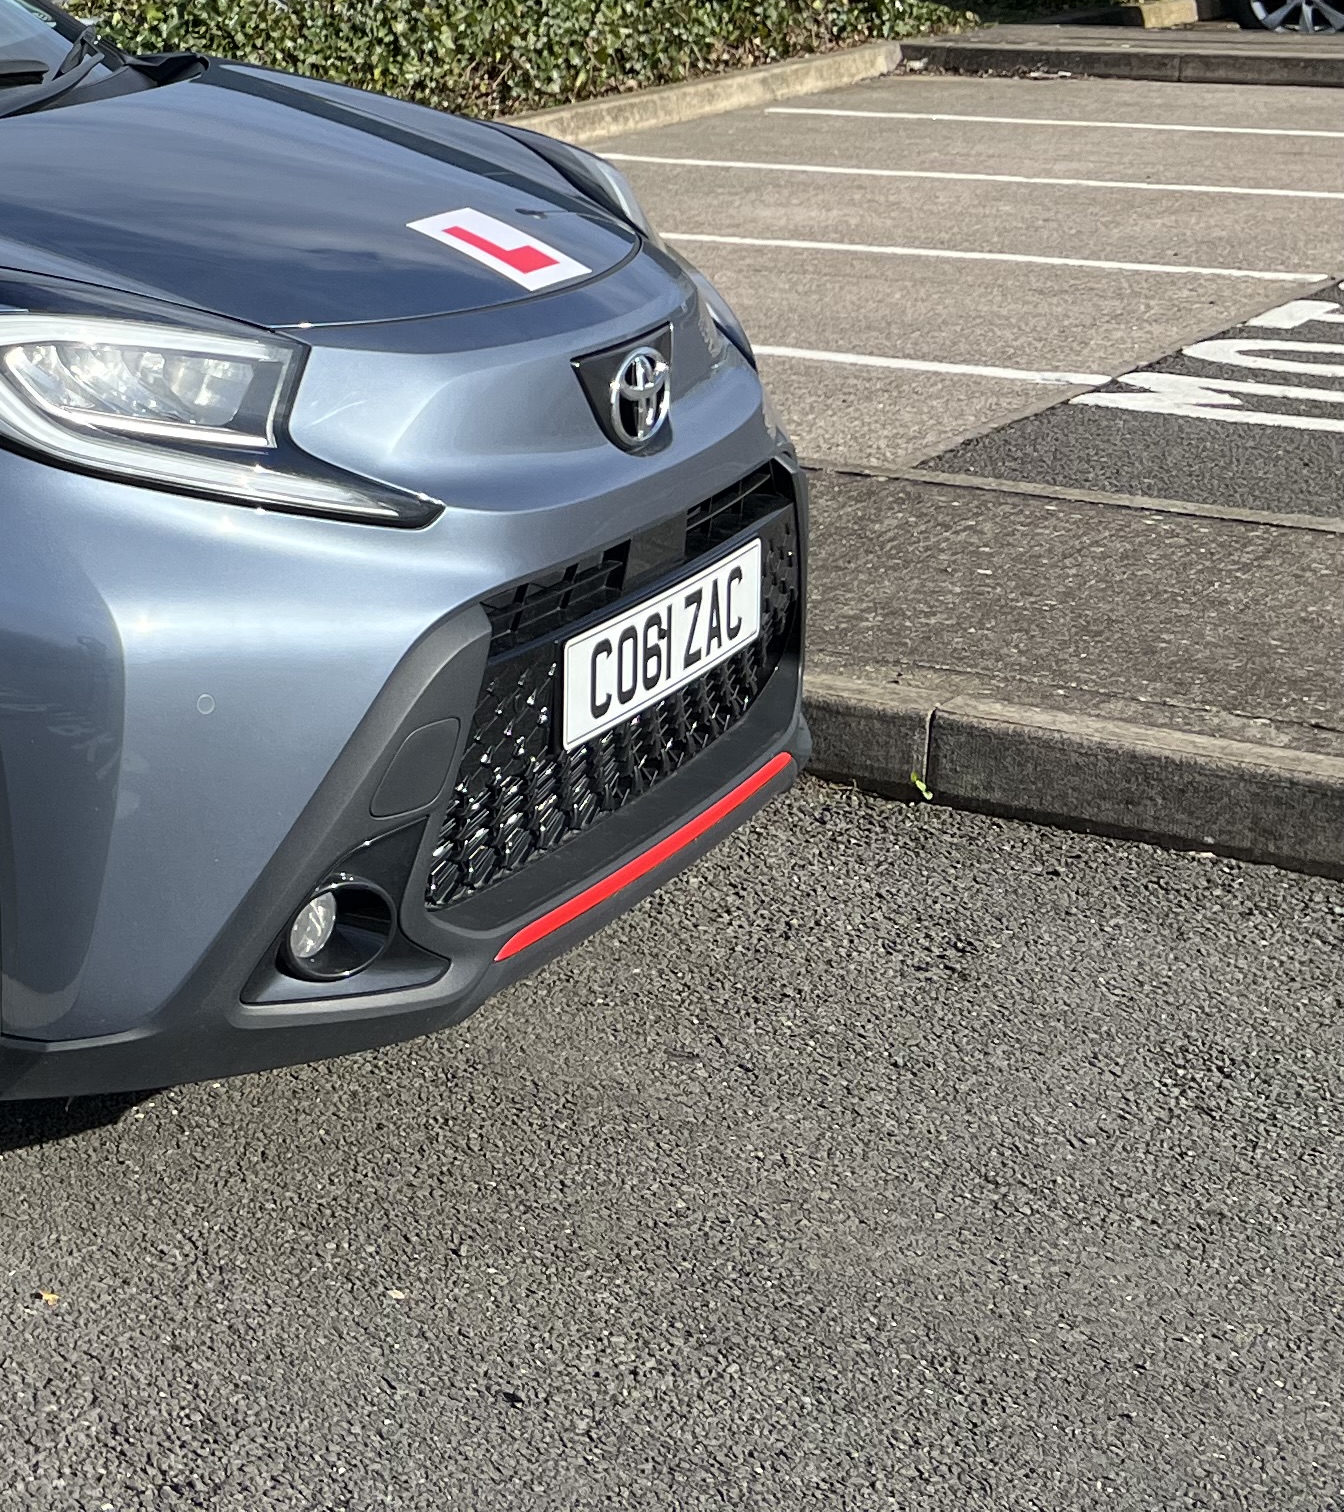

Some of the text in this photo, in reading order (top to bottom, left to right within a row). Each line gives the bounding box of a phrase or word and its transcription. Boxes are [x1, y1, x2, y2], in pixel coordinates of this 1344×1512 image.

[441, 226, 561, 275] L
[590, 565, 743, 720] CO61 ZAC
